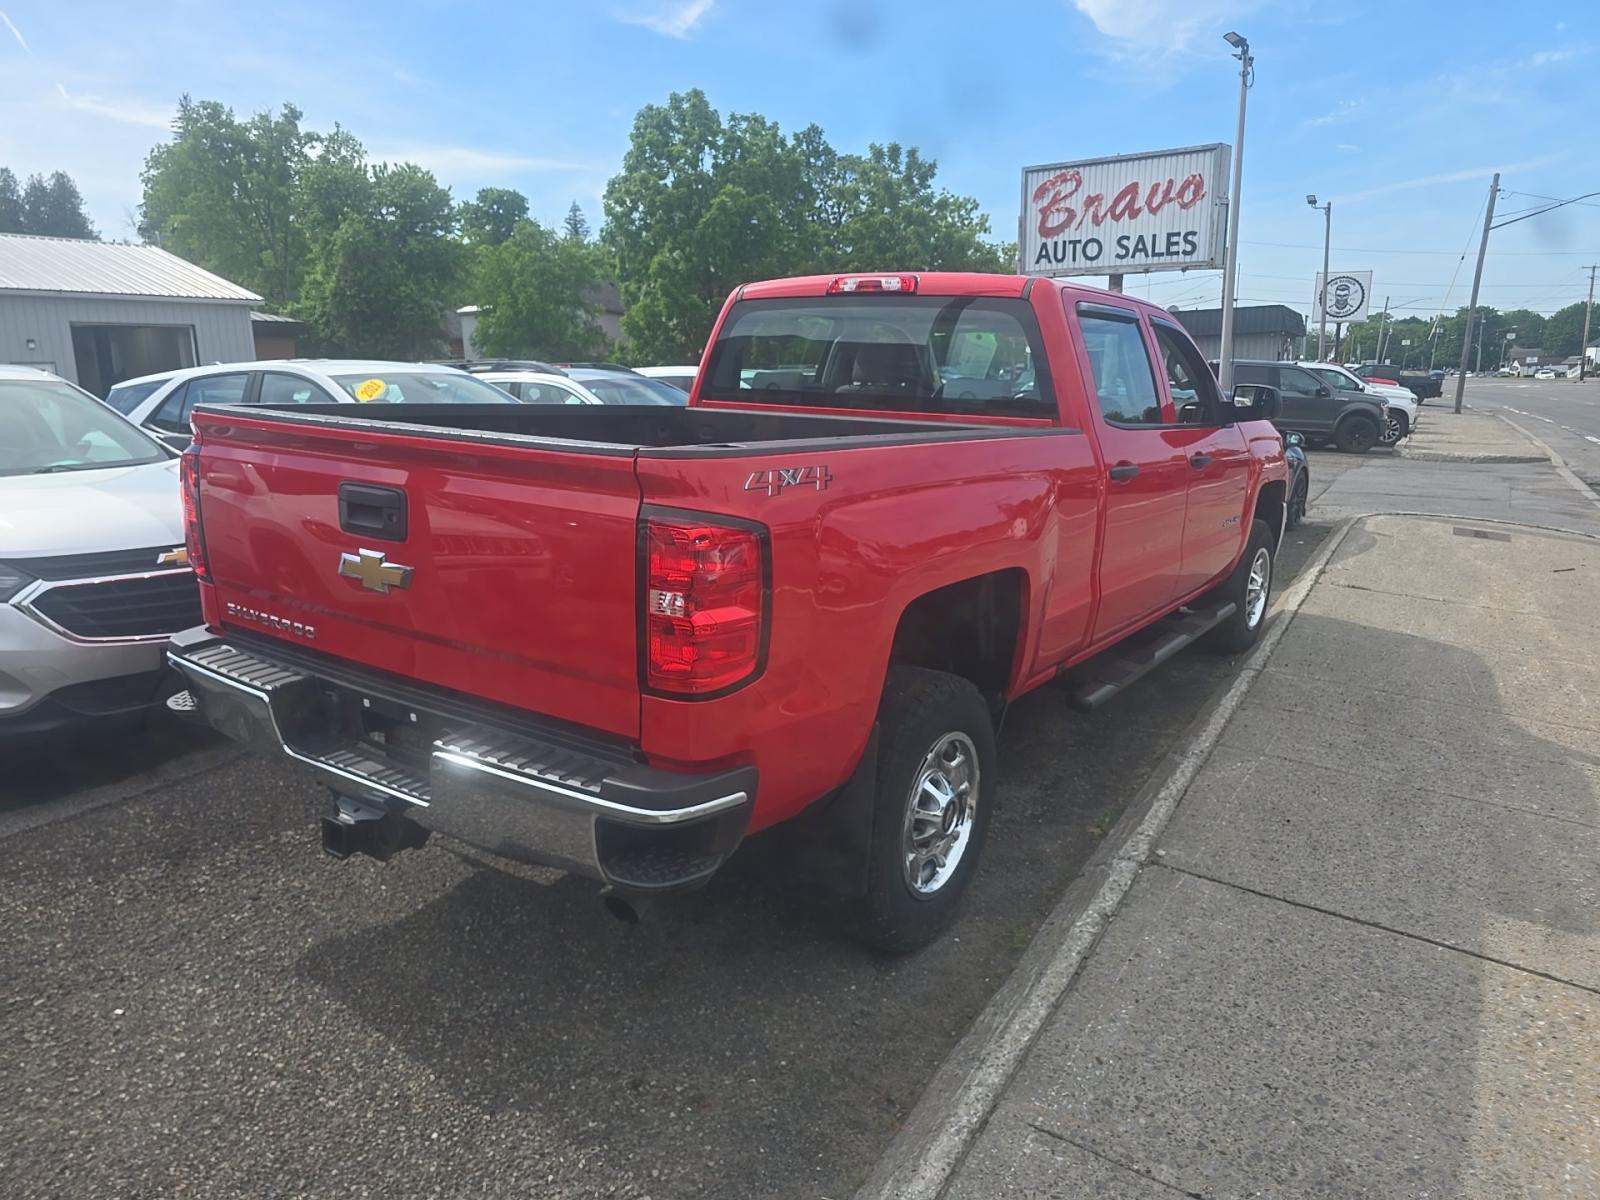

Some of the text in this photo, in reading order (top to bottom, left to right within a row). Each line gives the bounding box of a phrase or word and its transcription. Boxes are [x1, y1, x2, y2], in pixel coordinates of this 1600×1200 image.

[1033, 170, 1207, 239] Bravo
[1035, 231, 1198, 265] AUTO SALES
[227, 603, 316, 639] SILVERADO
